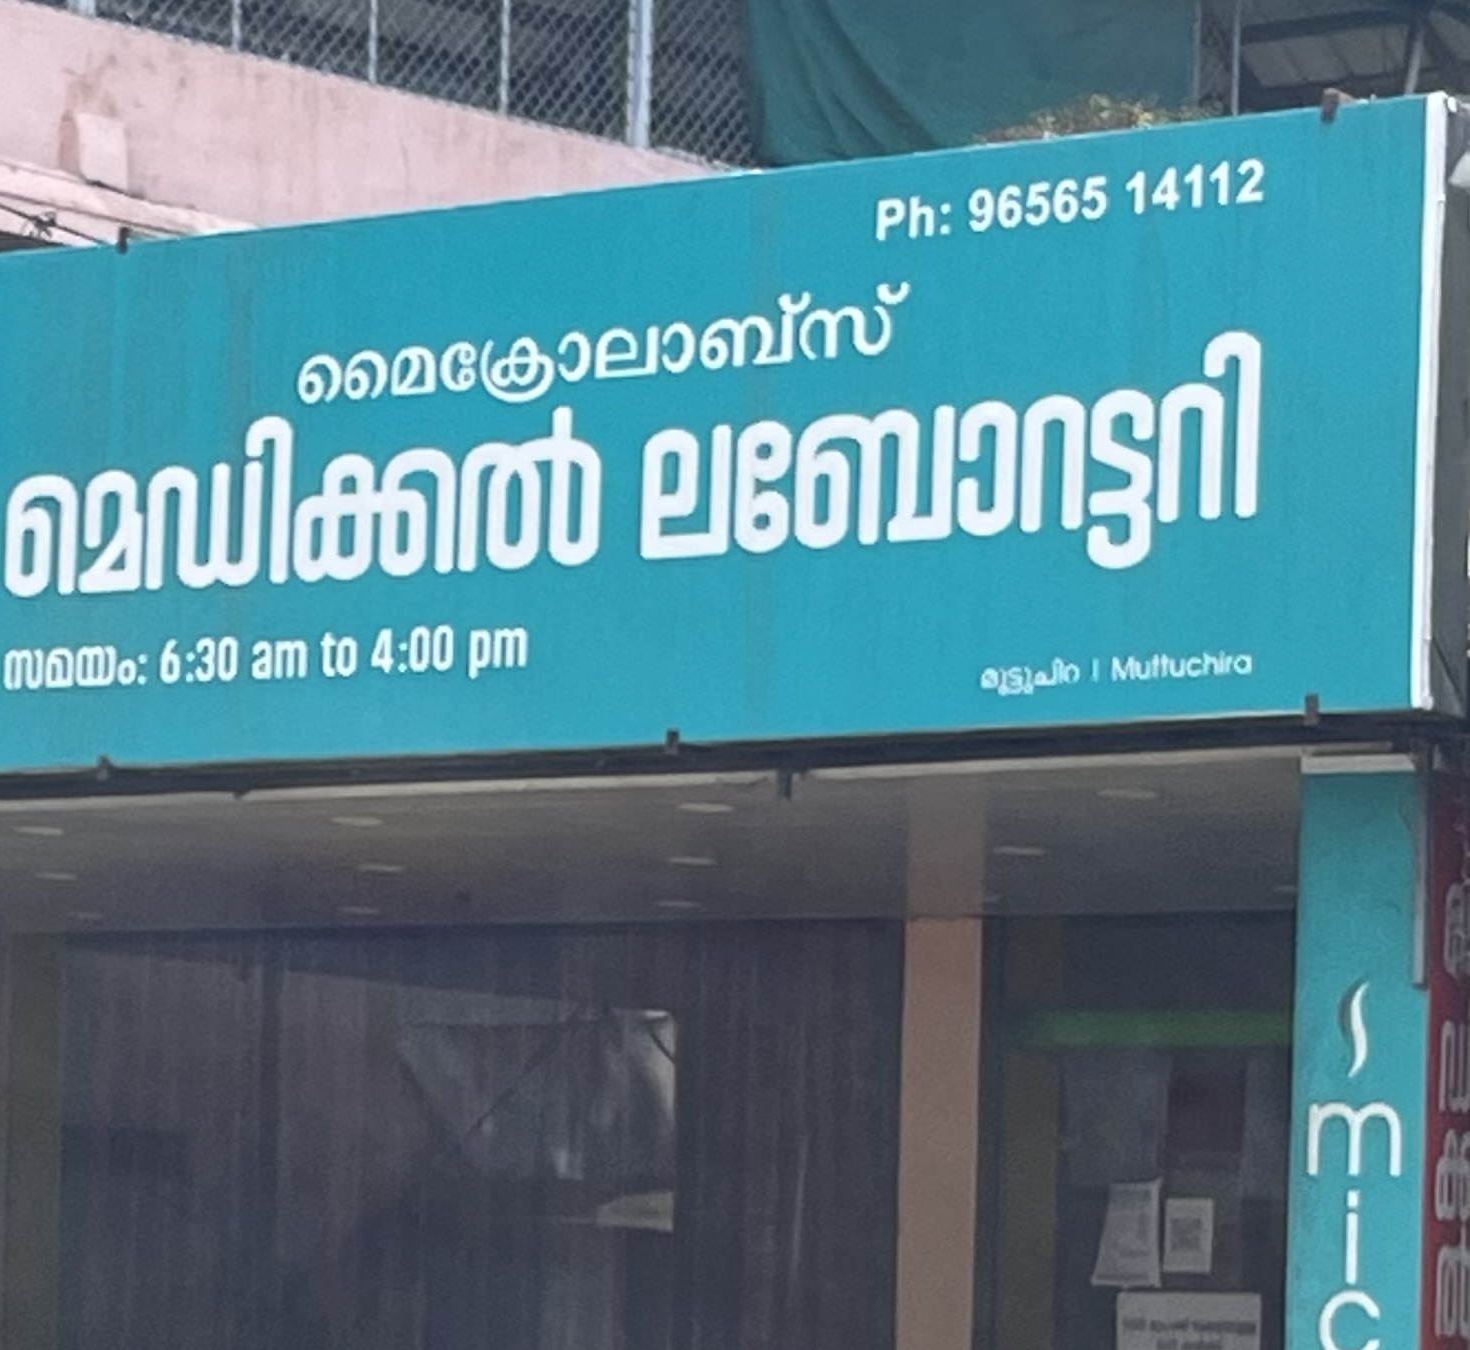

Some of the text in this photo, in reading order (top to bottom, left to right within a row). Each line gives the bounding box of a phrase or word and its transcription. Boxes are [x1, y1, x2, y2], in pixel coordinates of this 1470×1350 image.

[876, 158, 1265, 241] Ph: 96565 14112
[4, 331, 1262, 597] മെഡിക്കൽ ലബോറട്ടറി
[159, 636, 239, 684] 6:30
[251, 639, 308, 680] am
[320, 632, 358, 677] to
[370, 624, 454, 673] 4:00
[468, 627, 528, 679] pm
[1111, 651, 1253, 681] Muttuchira
